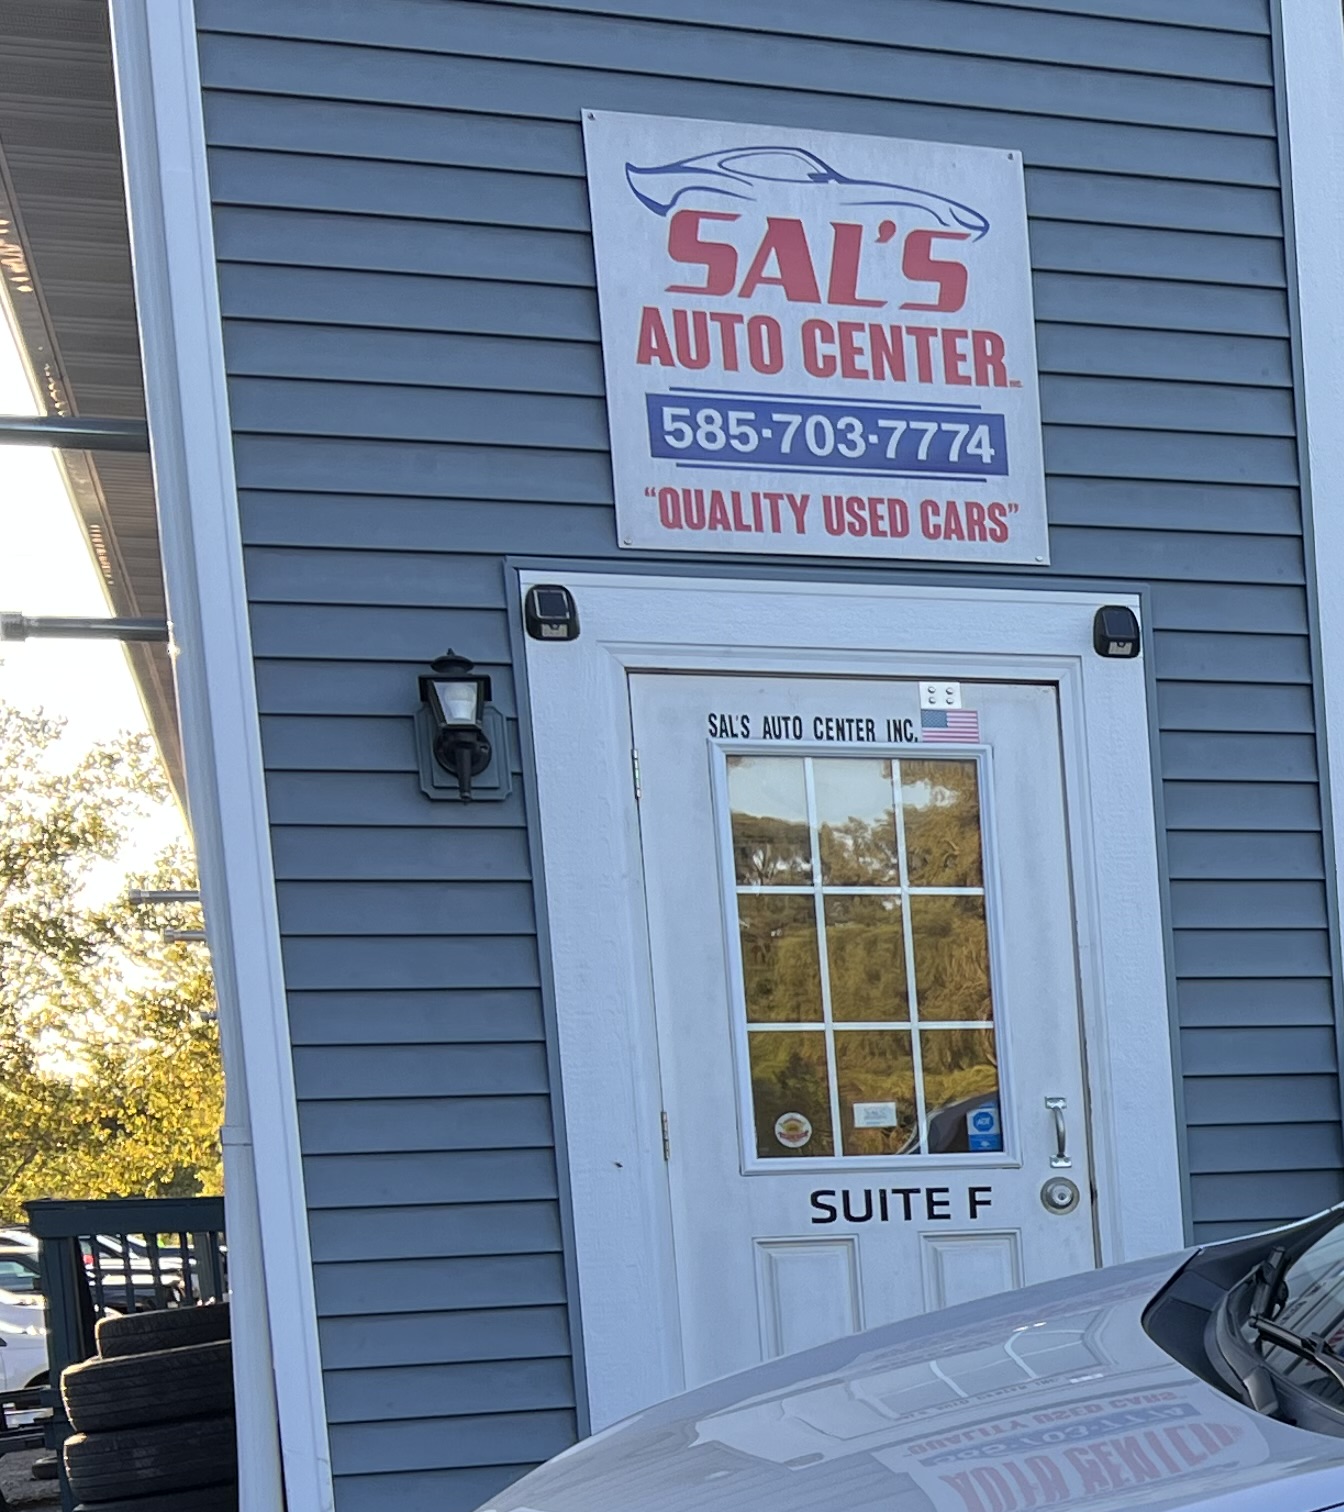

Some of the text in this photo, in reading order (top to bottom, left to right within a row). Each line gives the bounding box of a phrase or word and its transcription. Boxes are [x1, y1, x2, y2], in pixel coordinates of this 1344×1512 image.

[664, 208, 972, 313] SAL'S
[636, 305, 1008, 388] AUTO CENTER
[821, 494, 910, 539] USED
[708, 712, 919, 743] SAL'S AUTO CENTER INC.
[810, 1186, 993, 1224] SUITE F
